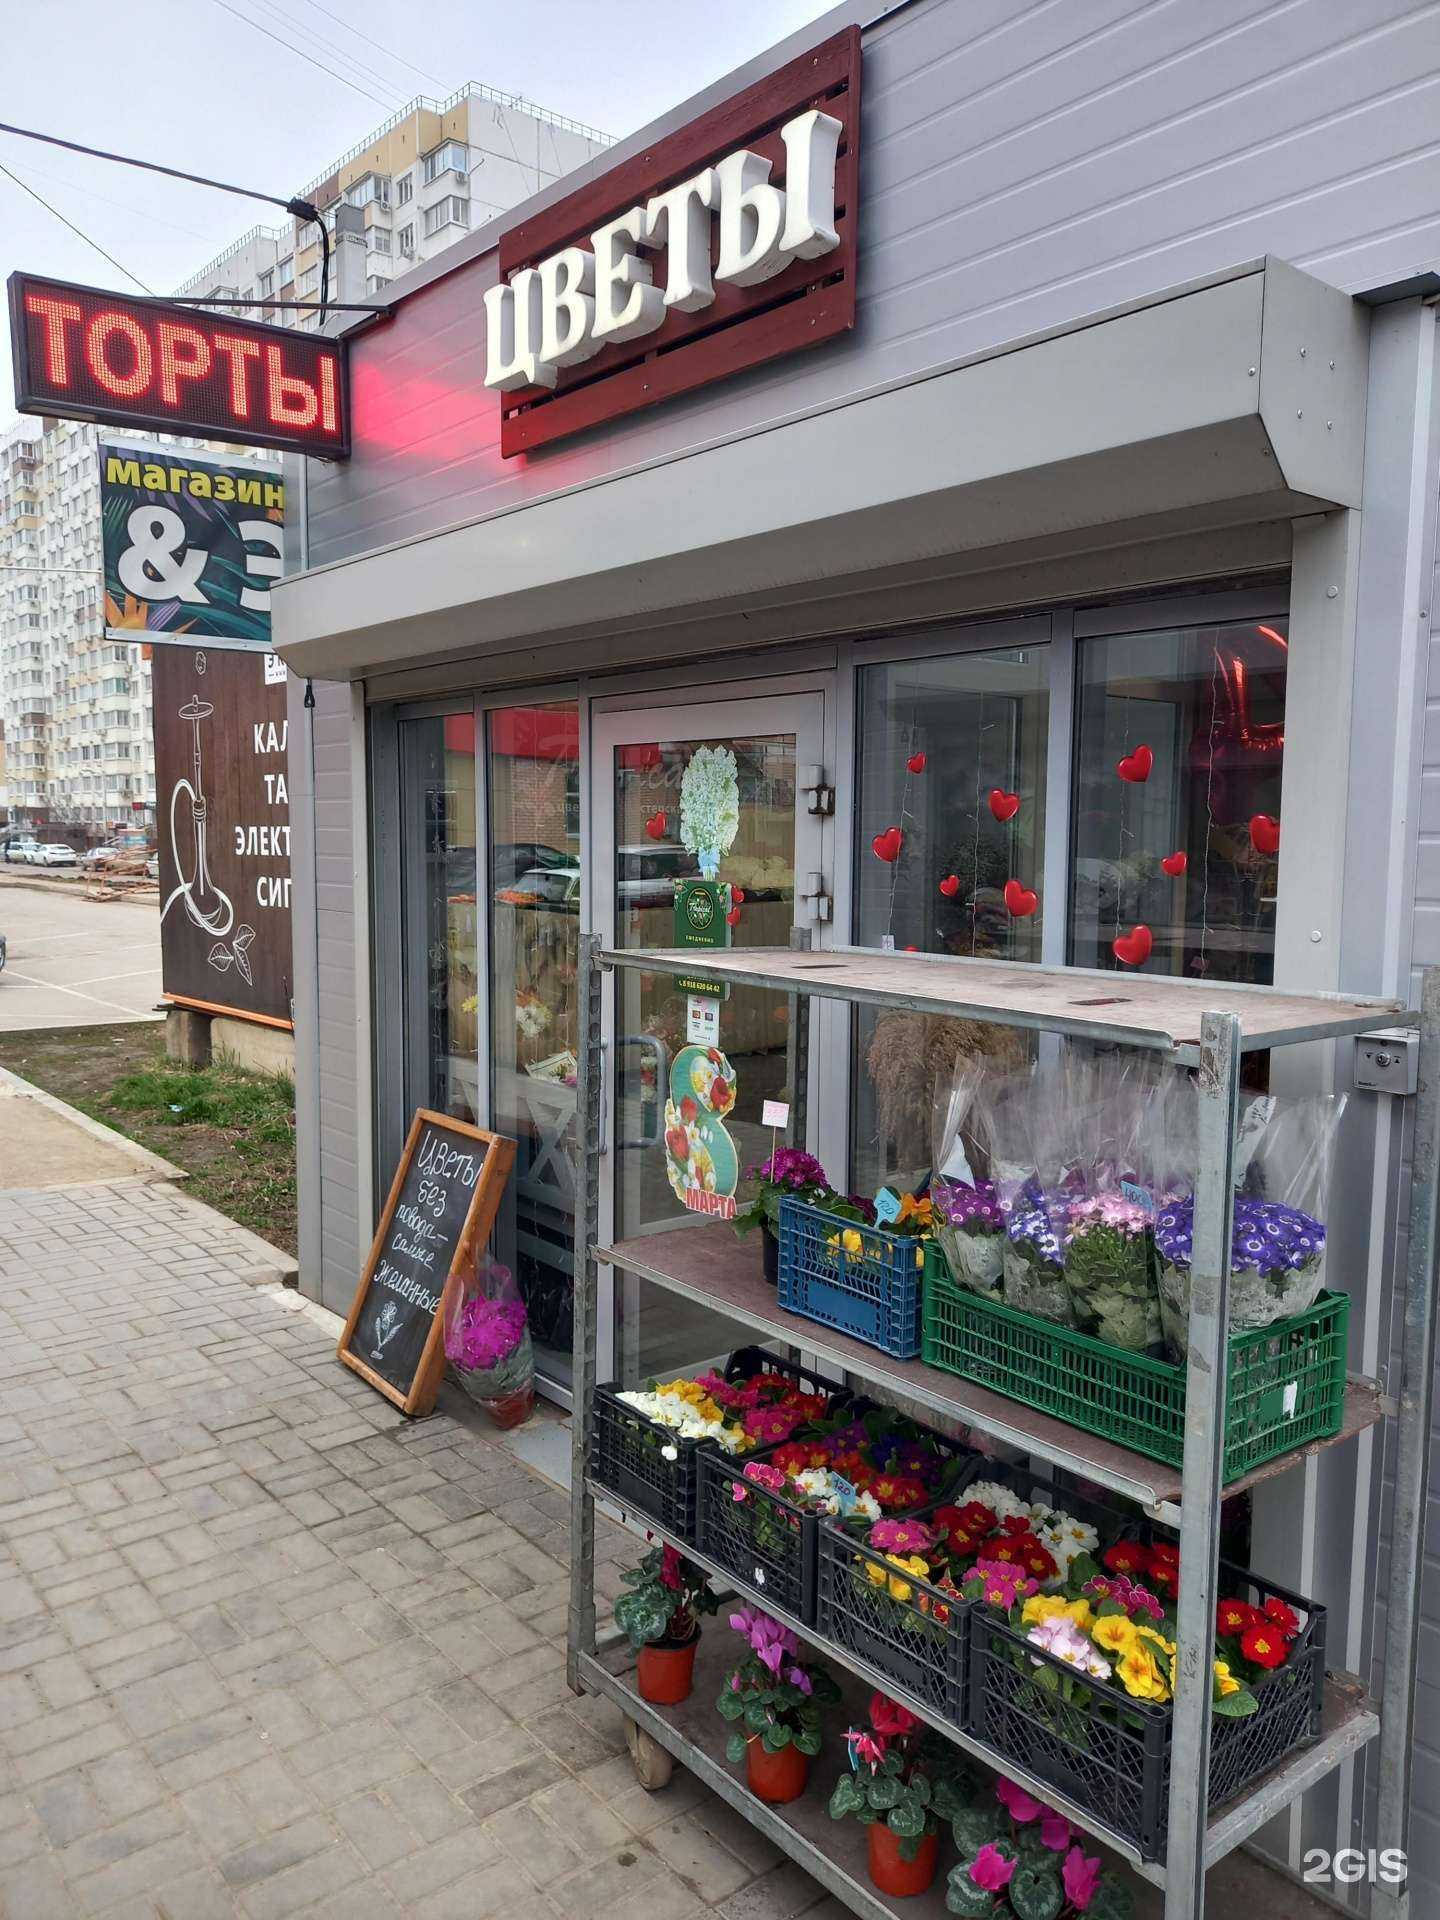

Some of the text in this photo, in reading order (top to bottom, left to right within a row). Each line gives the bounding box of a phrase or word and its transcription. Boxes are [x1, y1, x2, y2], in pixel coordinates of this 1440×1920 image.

[484, 110, 843, 392] ЦВЕТЫ
[27, 296, 338, 432] ТОРТЫ
[264, 774, 289, 804] ТА
[686, 1187, 737, 1220] МАРТА
